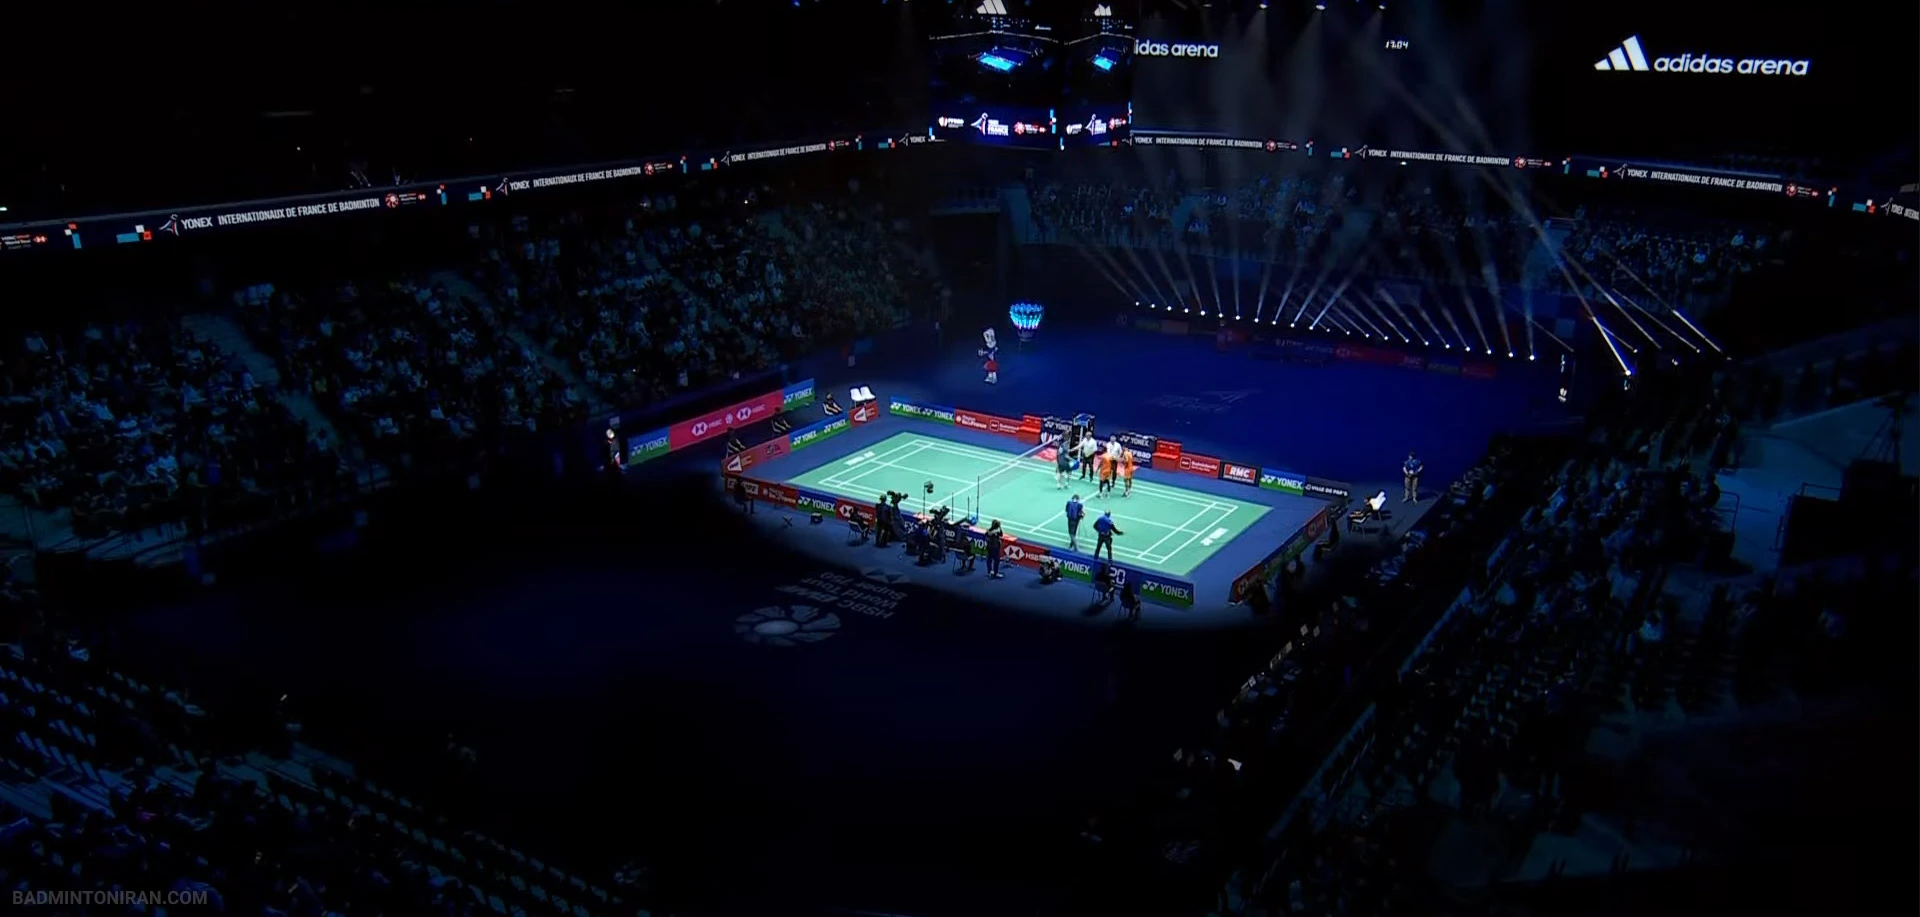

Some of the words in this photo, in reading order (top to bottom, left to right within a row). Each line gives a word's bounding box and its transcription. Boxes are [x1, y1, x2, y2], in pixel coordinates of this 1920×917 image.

[1134, 39, 1169, 56] idas
[1172, 42, 1219, 58] arena
[1654, 53, 1734, 74] adidas
[1737, 59, 1809, 76] arena
[1135, 136, 1152, 144] YONEX
[1156, 137, 1198, 146] INTERNATIONAUX
[1206, 138, 1226, 147] FRANCE
[1234, 140, 1262, 148] BADMINTON
[730, 152, 746, 162] YONEX
[785, 146, 800, 155] FRANCE
[1368, 148, 1387, 157] YONEX
[1390, 151, 1436, 161] INTERNATIONAUX
[1444, 154, 1466, 163] FRANCE
[1476, 156, 1510, 166] BADMINTON
[510, 180, 530, 191] YONEX
[533, 174, 578, 188] INTERNATIONAUX
[578, 172, 585, 182] DE
[586, 170, 605, 181] FRANCE
[606, 169, 612, 178] DE
[613, 166, 641, 177] BADMINTON
[1627, 168, 1648, 178] YONEX
[1651, 171, 1700, 183] INTERNATIONAUX
[1701, 175, 1710, 184] DE
[1710, 176, 1735, 187] FRANCE
[1736, 178, 1745, 188] DE
[1746, 180, 1783, 192] BADMINTON
[181, 217, 212, 230] YONEX
[218, 208, 285, 226] INTERNATIONAUX
[286, 207, 297, 218] DE
[298, 203, 327, 216] FRANCE
[328, 202, 339, 213] DE
[340, 198, 380, 212] BADMINTON
[794, 387, 813, 400] YONEX
[902, 404, 921, 414] YONEX
[934, 410, 954, 421] YONEX
[832, 419, 846, 430] YONEX
[1055, 423, 1072, 431] YONEX
[645, 436, 668, 451] YONEX
[802, 430, 817, 442] YONEX
[1130, 437, 1149, 447] YONEX
[1230, 466, 1250, 478] RMC
[1276, 477, 1304, 490] YONEX
[812, 499, 835, 512] YONEX
[1064, 560, 1090, 576] YONEX
[1160, 583, 1189, 599] YONEX
